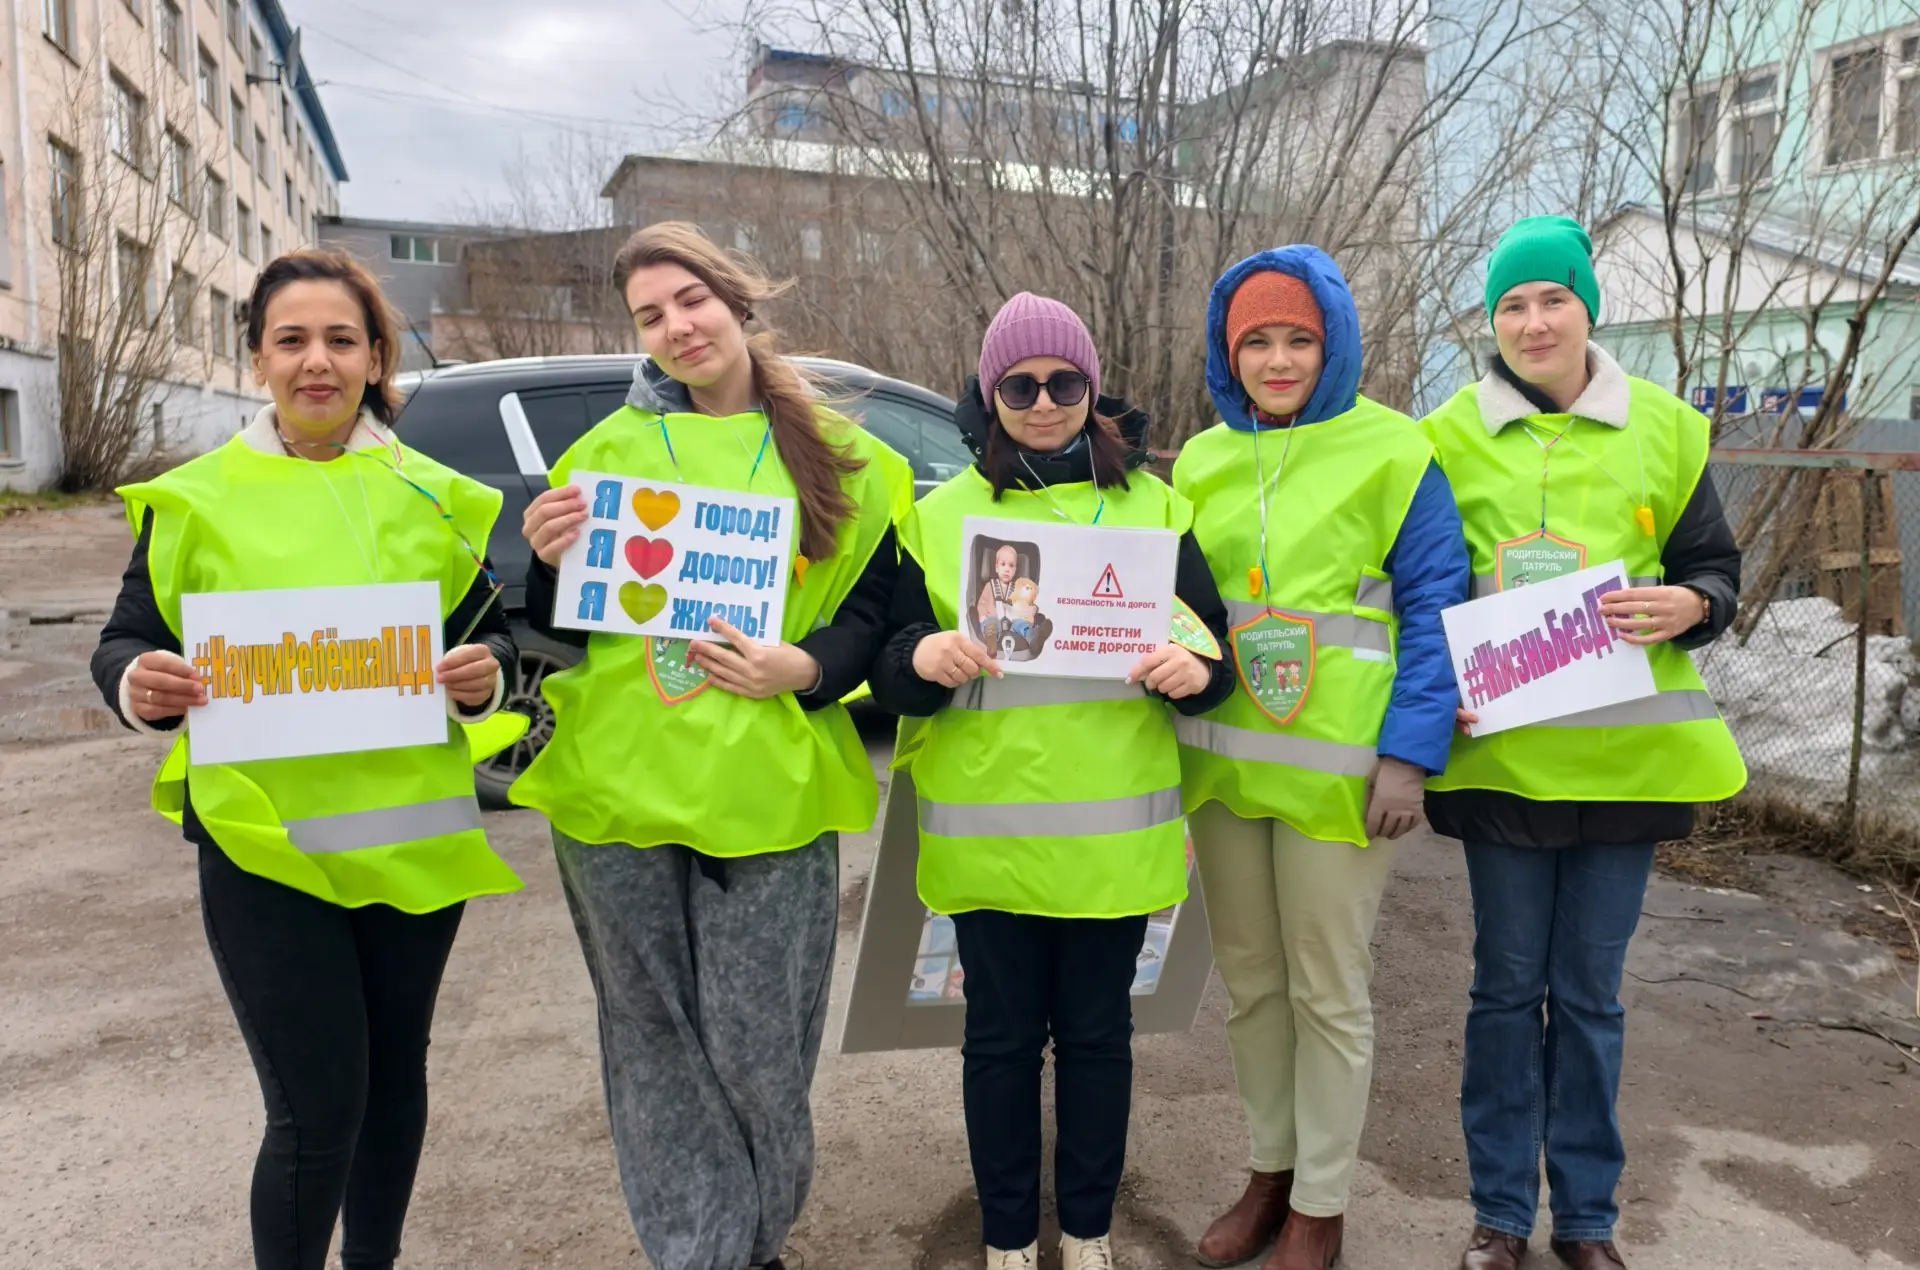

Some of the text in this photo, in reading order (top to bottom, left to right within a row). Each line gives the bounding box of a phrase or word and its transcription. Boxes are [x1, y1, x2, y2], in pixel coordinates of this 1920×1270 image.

[592, 479, 781, 543] Я город!
[586, 528, 778, 590] Я дорогу!
[1506, 549, 1577, 560] РОДИТЕЛЬСКИЙ
[1522, 562, 1562, 572] ПАТРУЛЬ
[577, 581, 608, 621] Я
[1057, 597, 1114, 608] БЕЗОПАСНОСТЬ
[1128, 602, 1157, 610] ДОРОГЕ
[1071, 625, 1142, 638] ПРИСТЕГНИ
[1240, 625, 1307, 642] РОДИТЕЛЬСКИЙ
[1054, 640, 1157, 654] САМОЕ ДОРОГОЕ!
[1257, 640, 1296, 652] ПАТРУЛЬ
